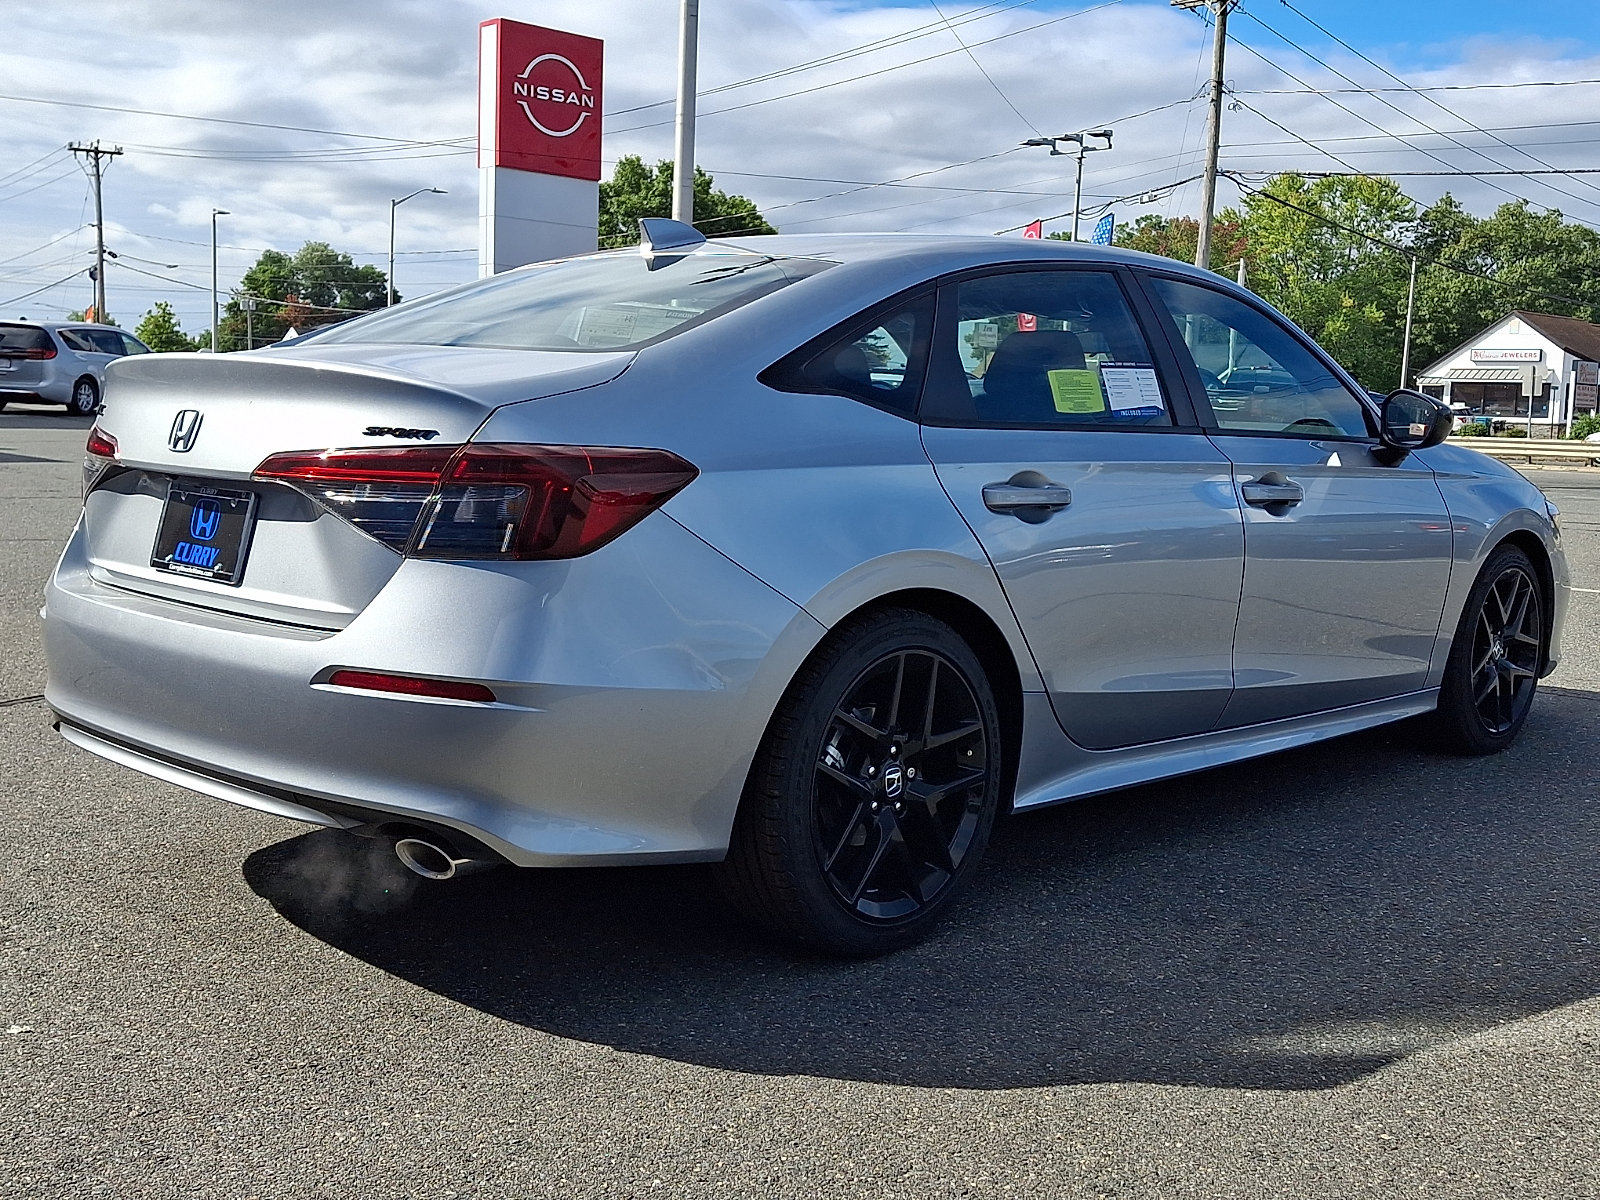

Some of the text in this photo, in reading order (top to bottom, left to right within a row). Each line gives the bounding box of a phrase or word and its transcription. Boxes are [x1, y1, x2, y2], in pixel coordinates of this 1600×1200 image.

[513, 81, 594, 109] NISSAN
[1500, 351, 1538, 359] JEWELERS
[361, 426, 441, 441] SPORT
[174, 541, 220, 568] CURRY
